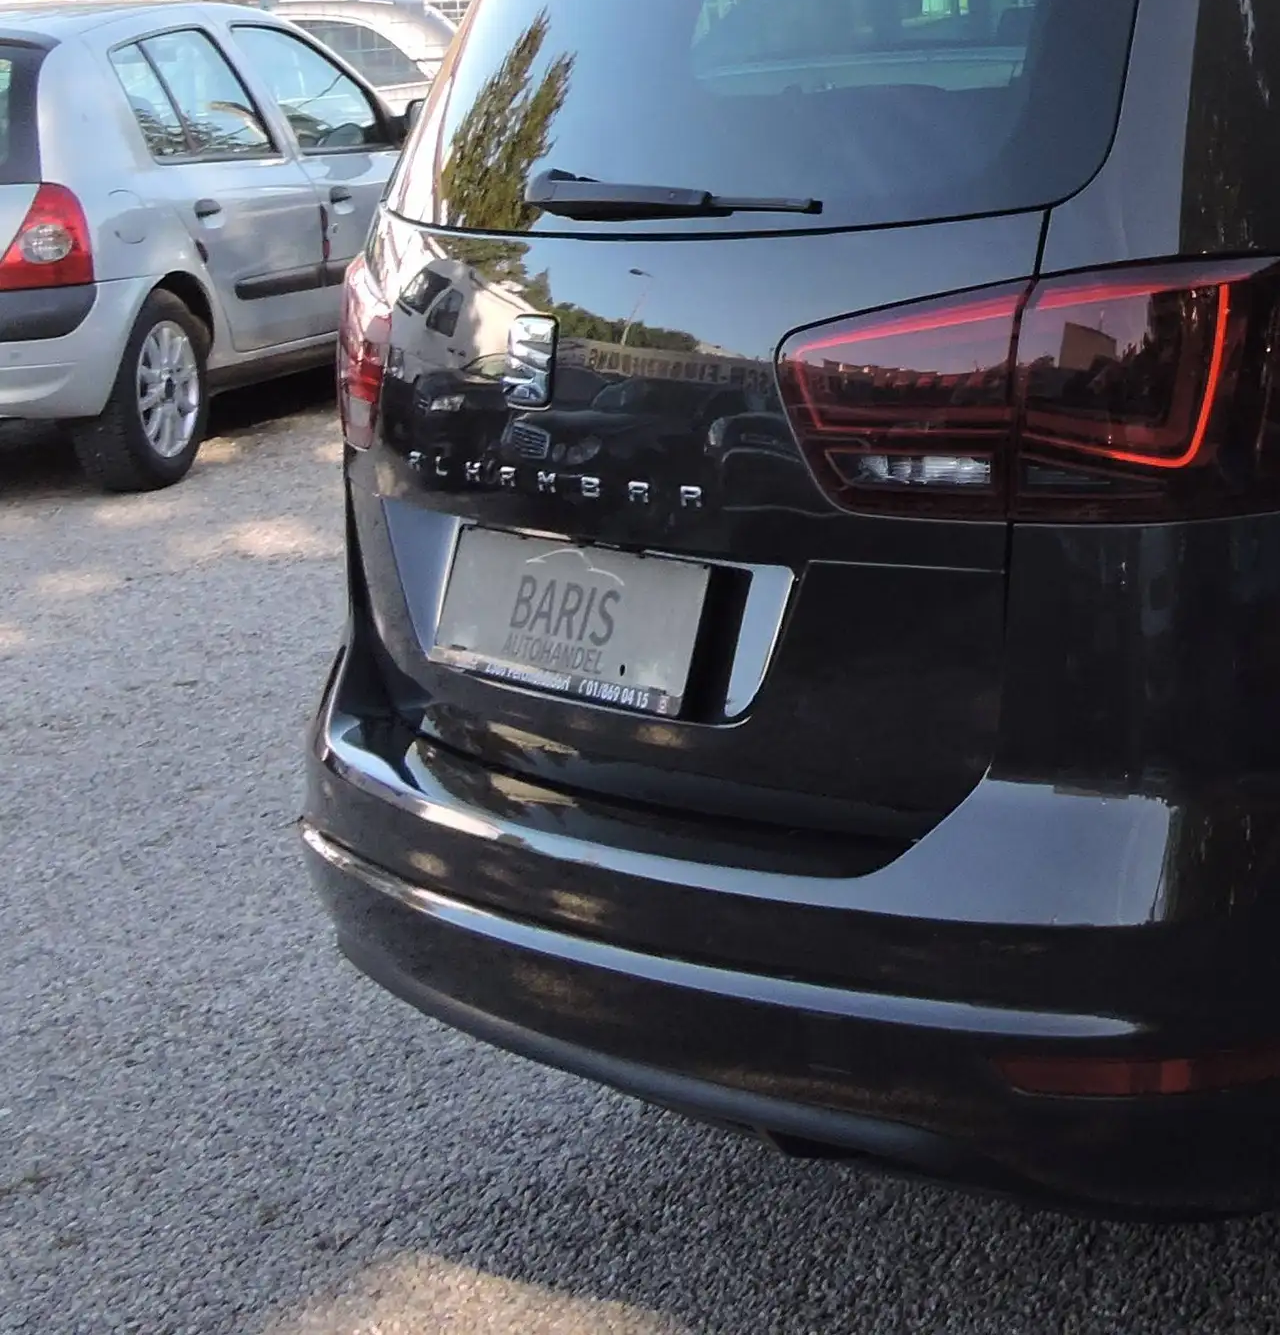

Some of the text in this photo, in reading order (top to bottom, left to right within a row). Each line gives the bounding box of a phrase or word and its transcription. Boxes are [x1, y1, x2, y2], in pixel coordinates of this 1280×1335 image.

[407, 450, 702, 508] ALHAMBRA
[509, 574, 621, 647] BARIS
[502, 631, 604, 675] AUTOHANDEL
[621, 687, 635, 706] 04
[636, 691, 650, 710] 15
